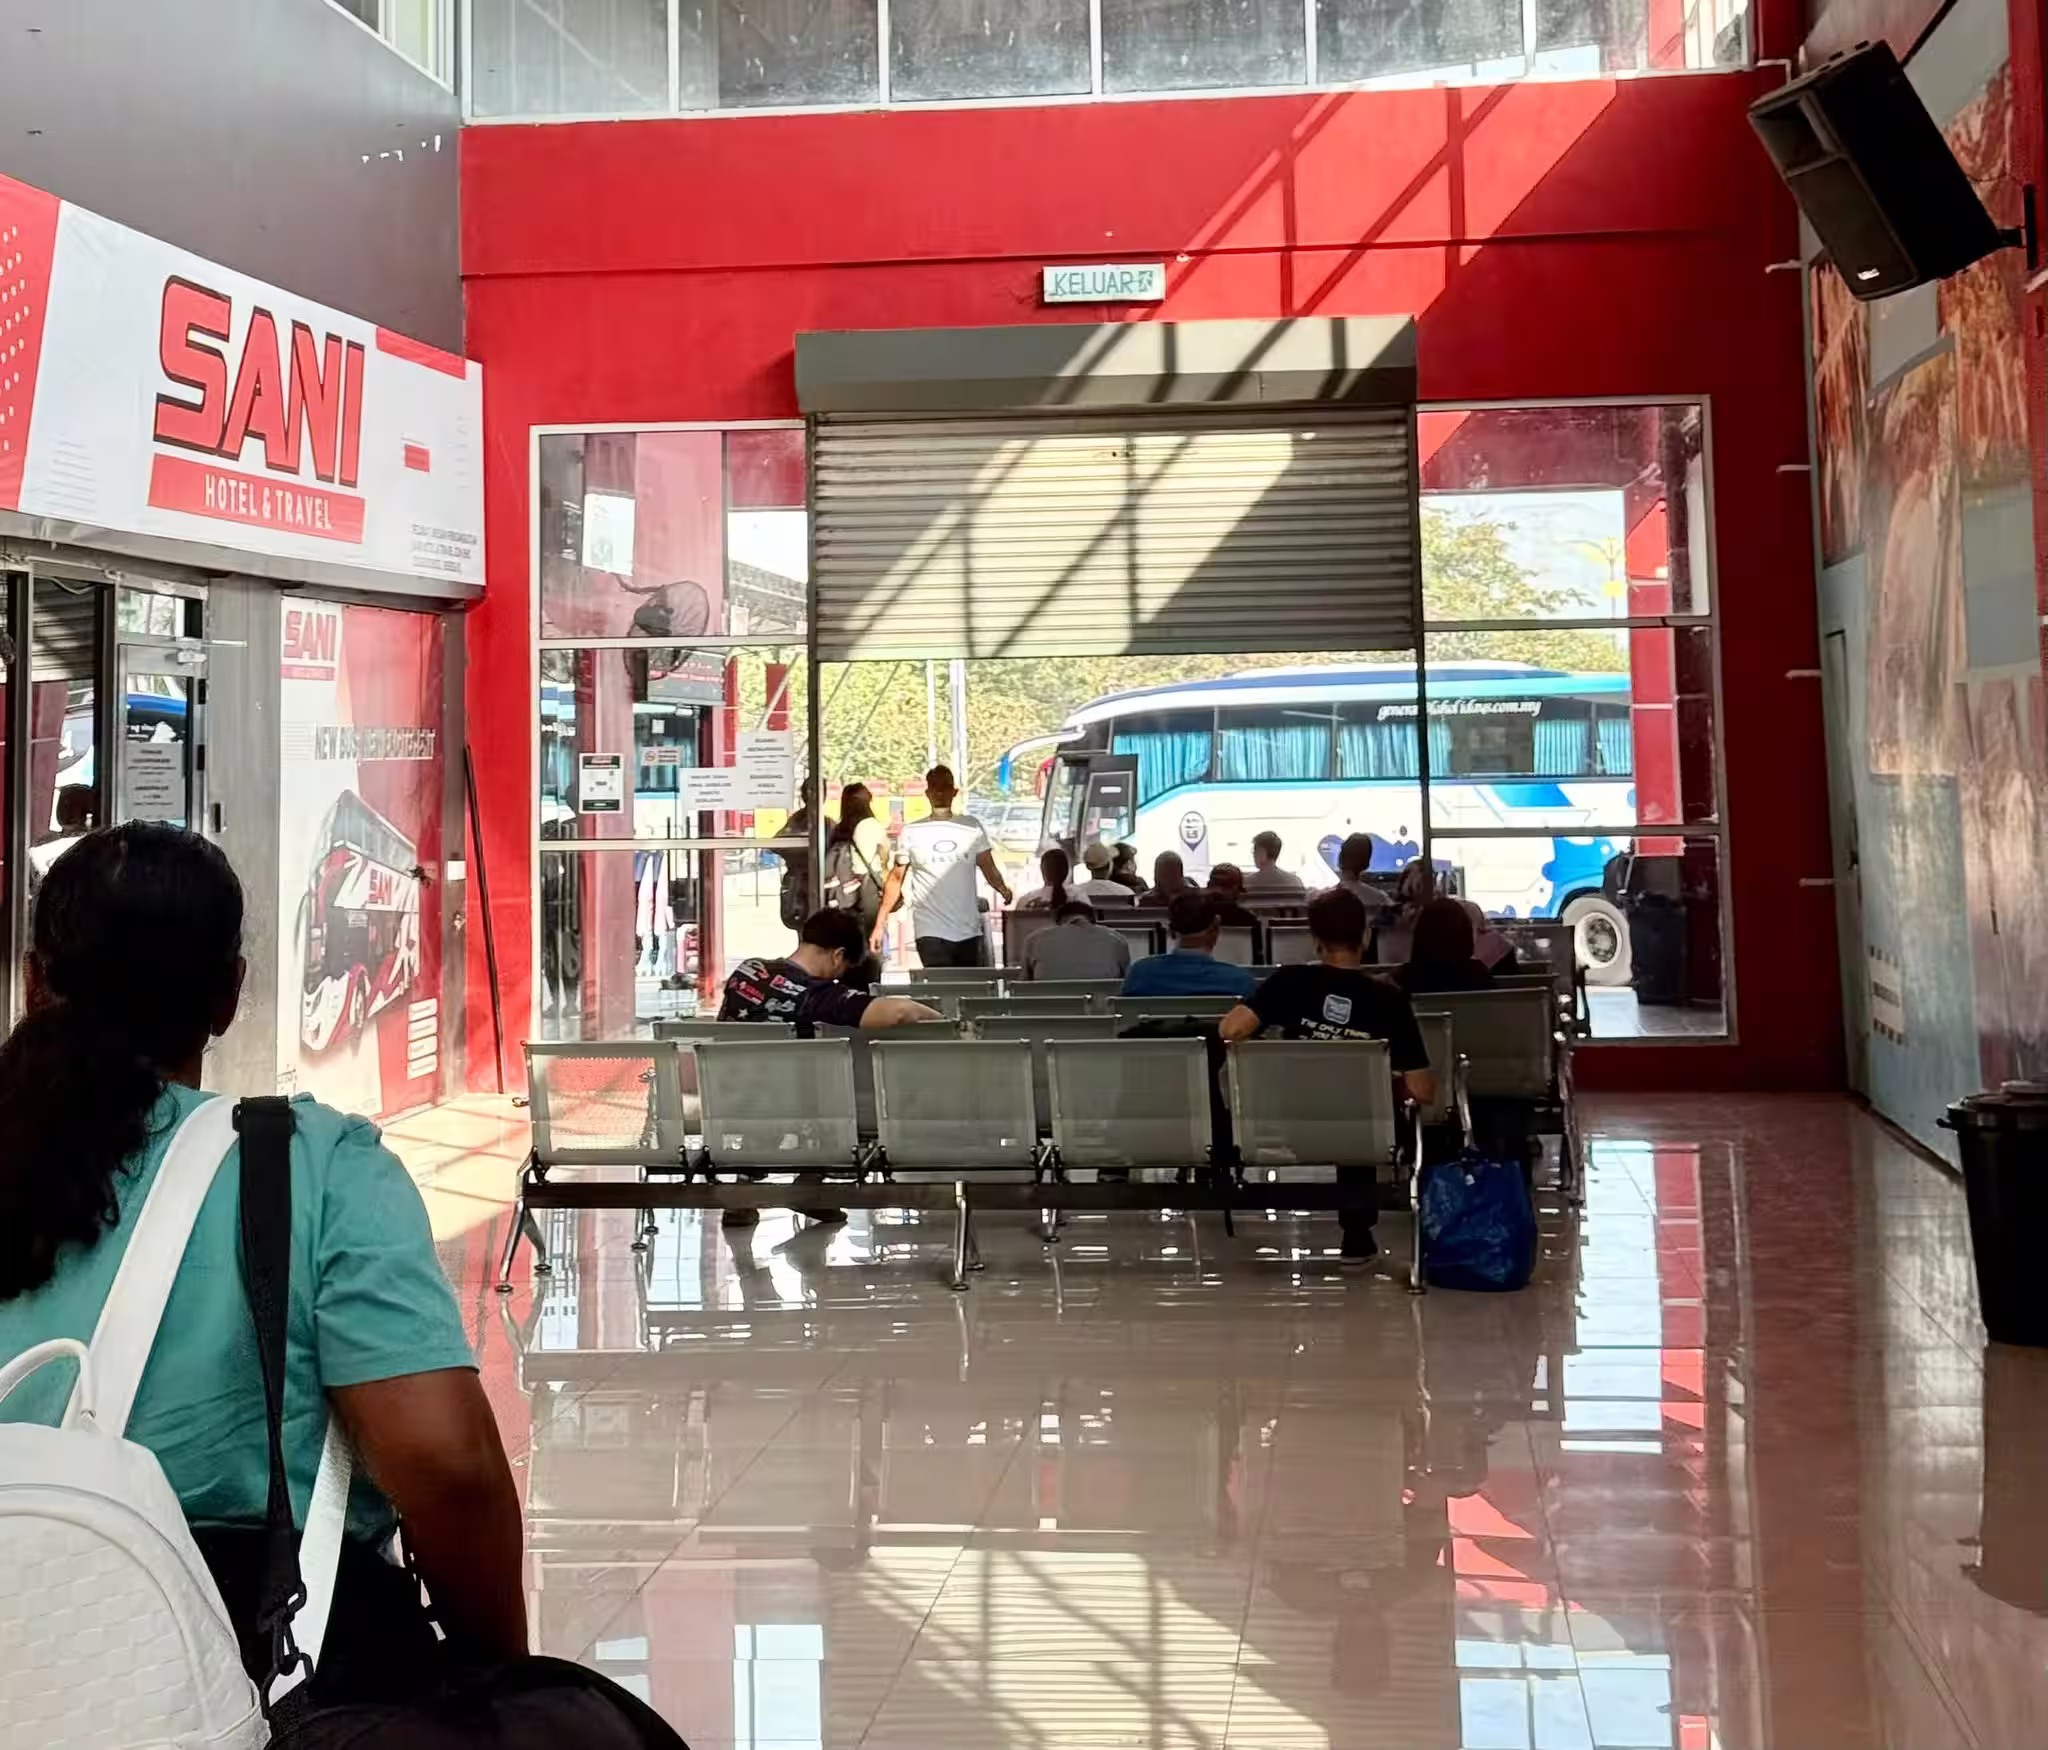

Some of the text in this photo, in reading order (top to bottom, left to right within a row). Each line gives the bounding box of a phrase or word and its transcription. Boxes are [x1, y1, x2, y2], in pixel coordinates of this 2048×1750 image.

[1054, 271, 1133, 296] KELUAR
[153, 274, 365, 489] SANI
[204, 474, 333, 530] HOTEL & TRAVEL
[283, 610, 337, 662] SANI
[315, 725, 338, 760] NEW
[369, 868, 393, 905] SANI
